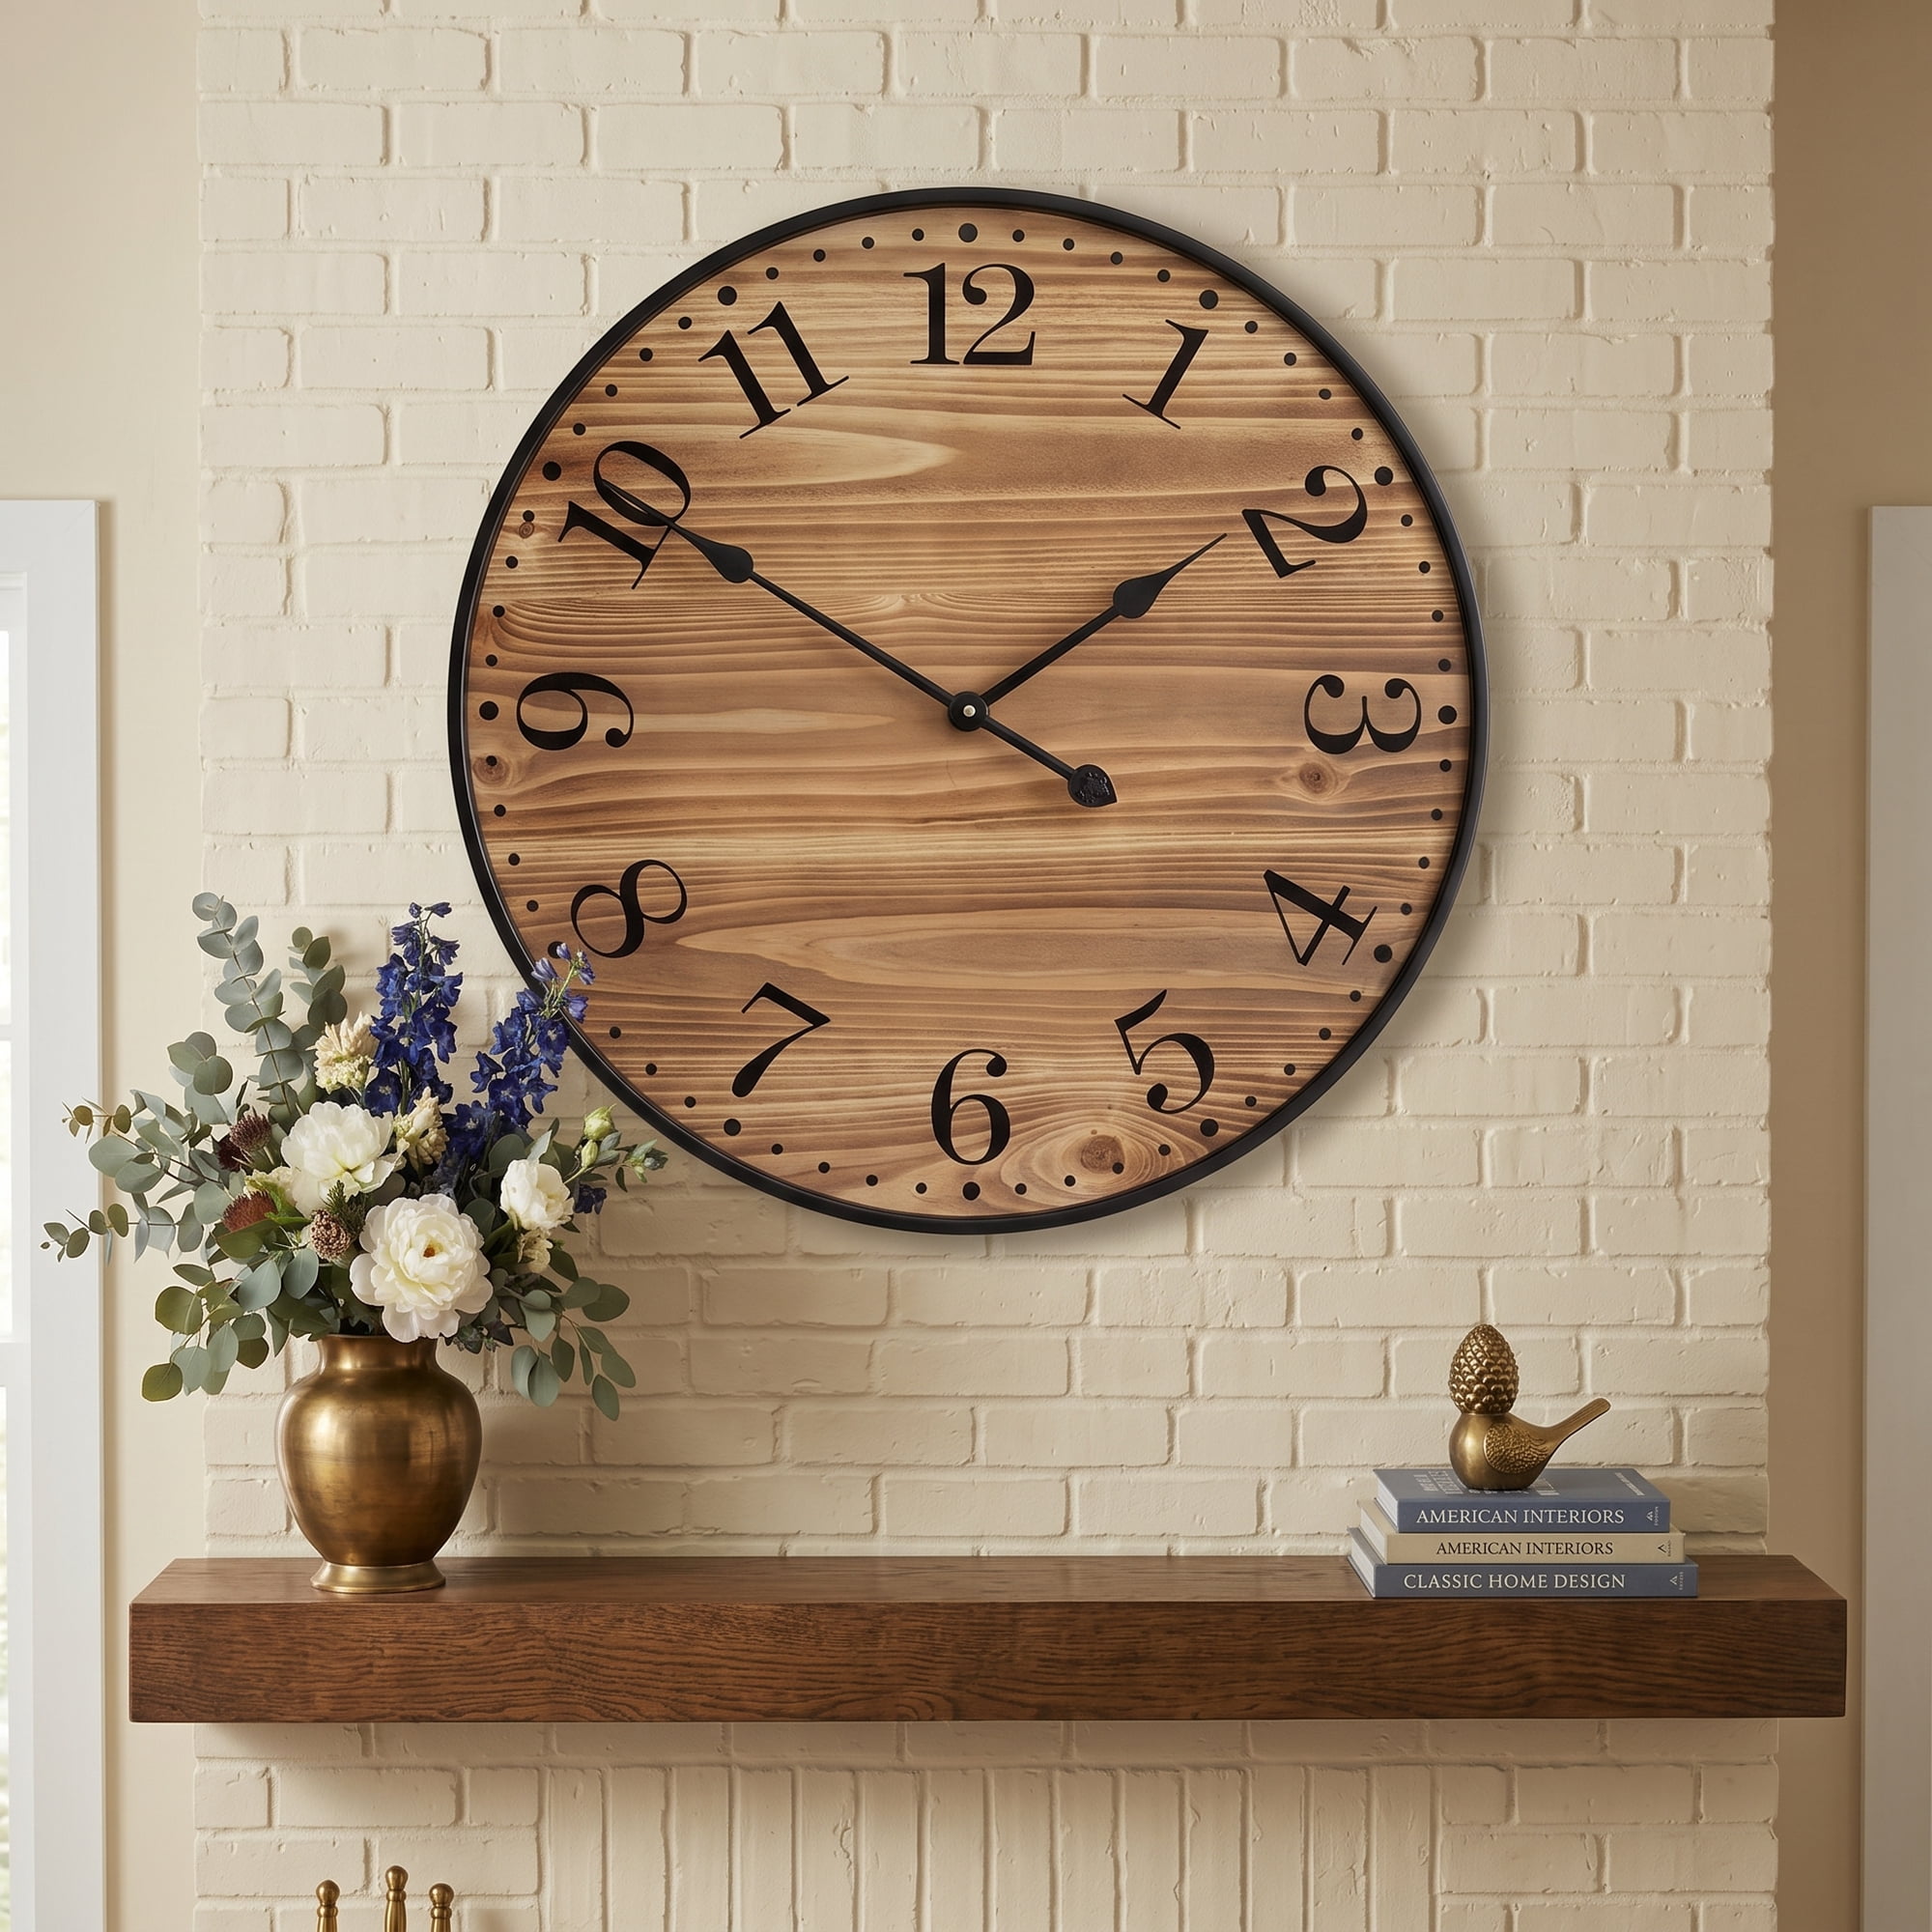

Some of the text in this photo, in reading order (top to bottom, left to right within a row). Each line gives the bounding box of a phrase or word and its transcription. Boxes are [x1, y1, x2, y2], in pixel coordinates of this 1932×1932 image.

[902, 261, 1037, 366] 12
[697, 300, 850, 440] 11
[1122, 319, 1209, 430] 1
[556, 440, 692, 590] 10
[1241, 465, 1369, 580] 2
[516, 670, 635, 752] 9
[1303, 673, 1422, 755] 3
[570, 859, 688, 959] 8
[1263, 868, 1378, 967] 4
[731, 981, 832, 1098] 7
[1114, 988, 1215, 1115] 5
[930, 1048, 1011, 1166] 6
[1415, 1508, 1625, 1525] AMERICAN INTERIORS
[1435, 1541, 1614, 1556] AMERICAN INTERIORS
[1404, 1573, 1626, 1590] CLASSIC HOME DESIGN
